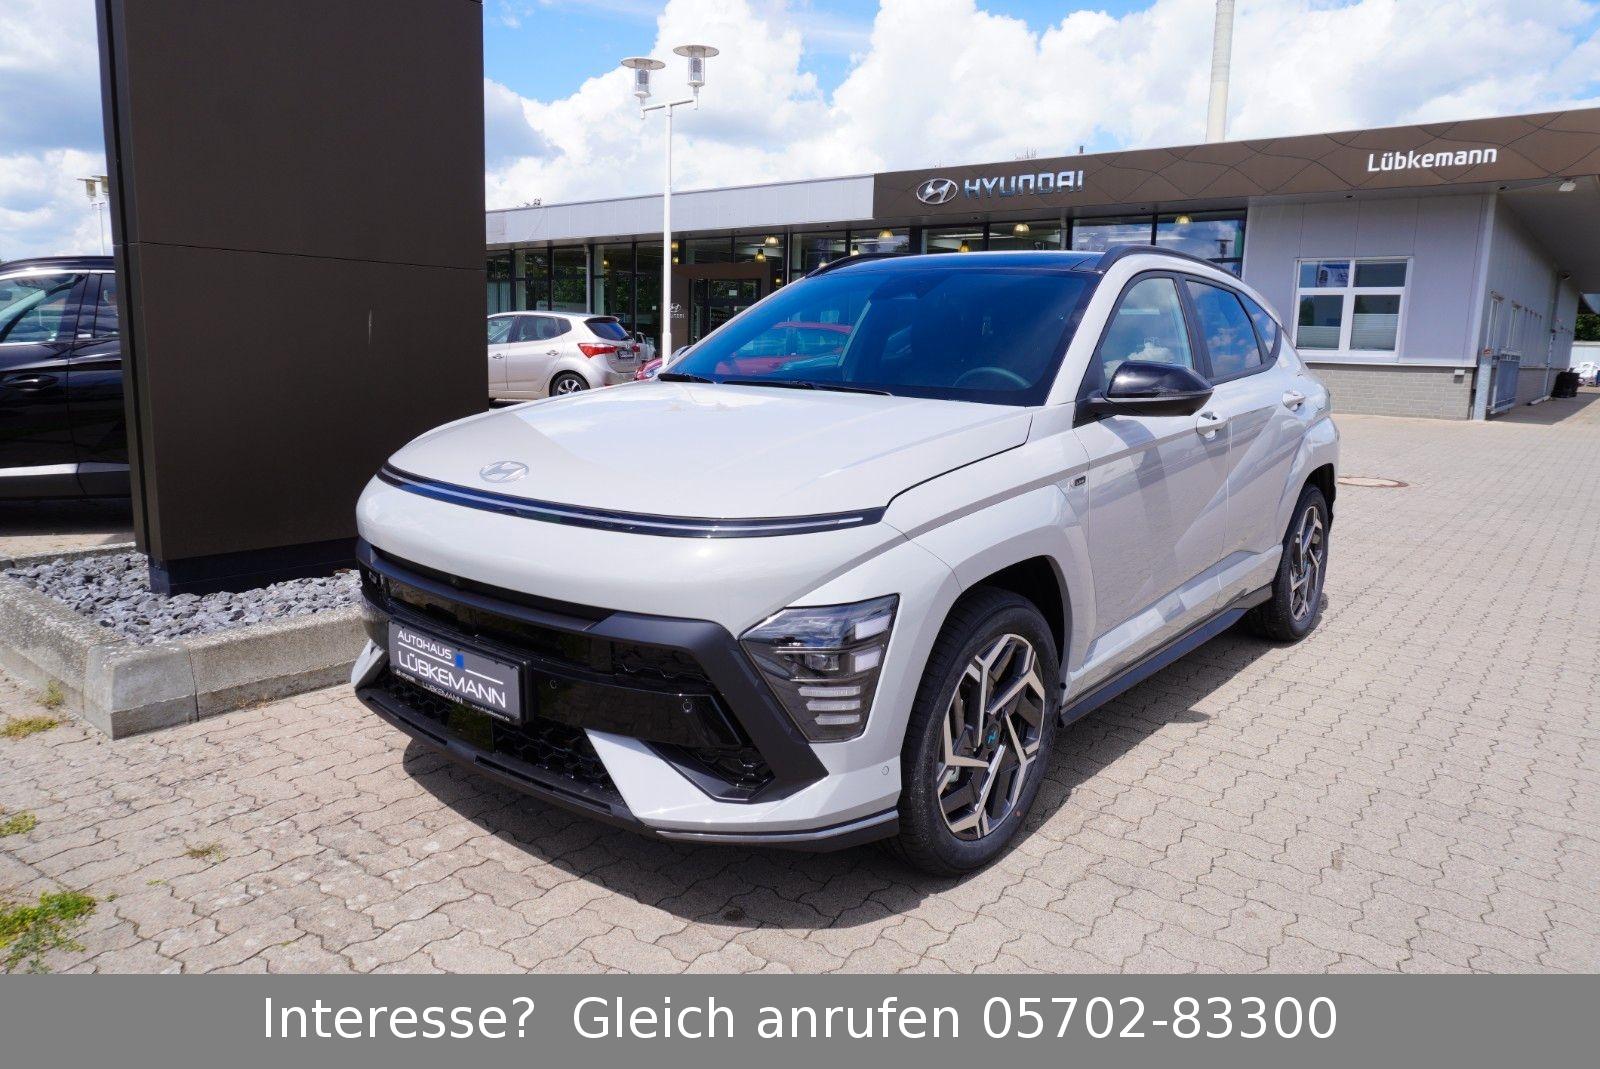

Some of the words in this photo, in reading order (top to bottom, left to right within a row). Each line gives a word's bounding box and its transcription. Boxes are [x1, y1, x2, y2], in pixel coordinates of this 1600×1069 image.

[1367, 148, 1498, 172] Lübkemann
[964, 170, 1084, 200] HYUNDAI
[397, 630, 452, 660] AUTOHAUS
[398, 650, 506, 708] LÜBKEMANN
